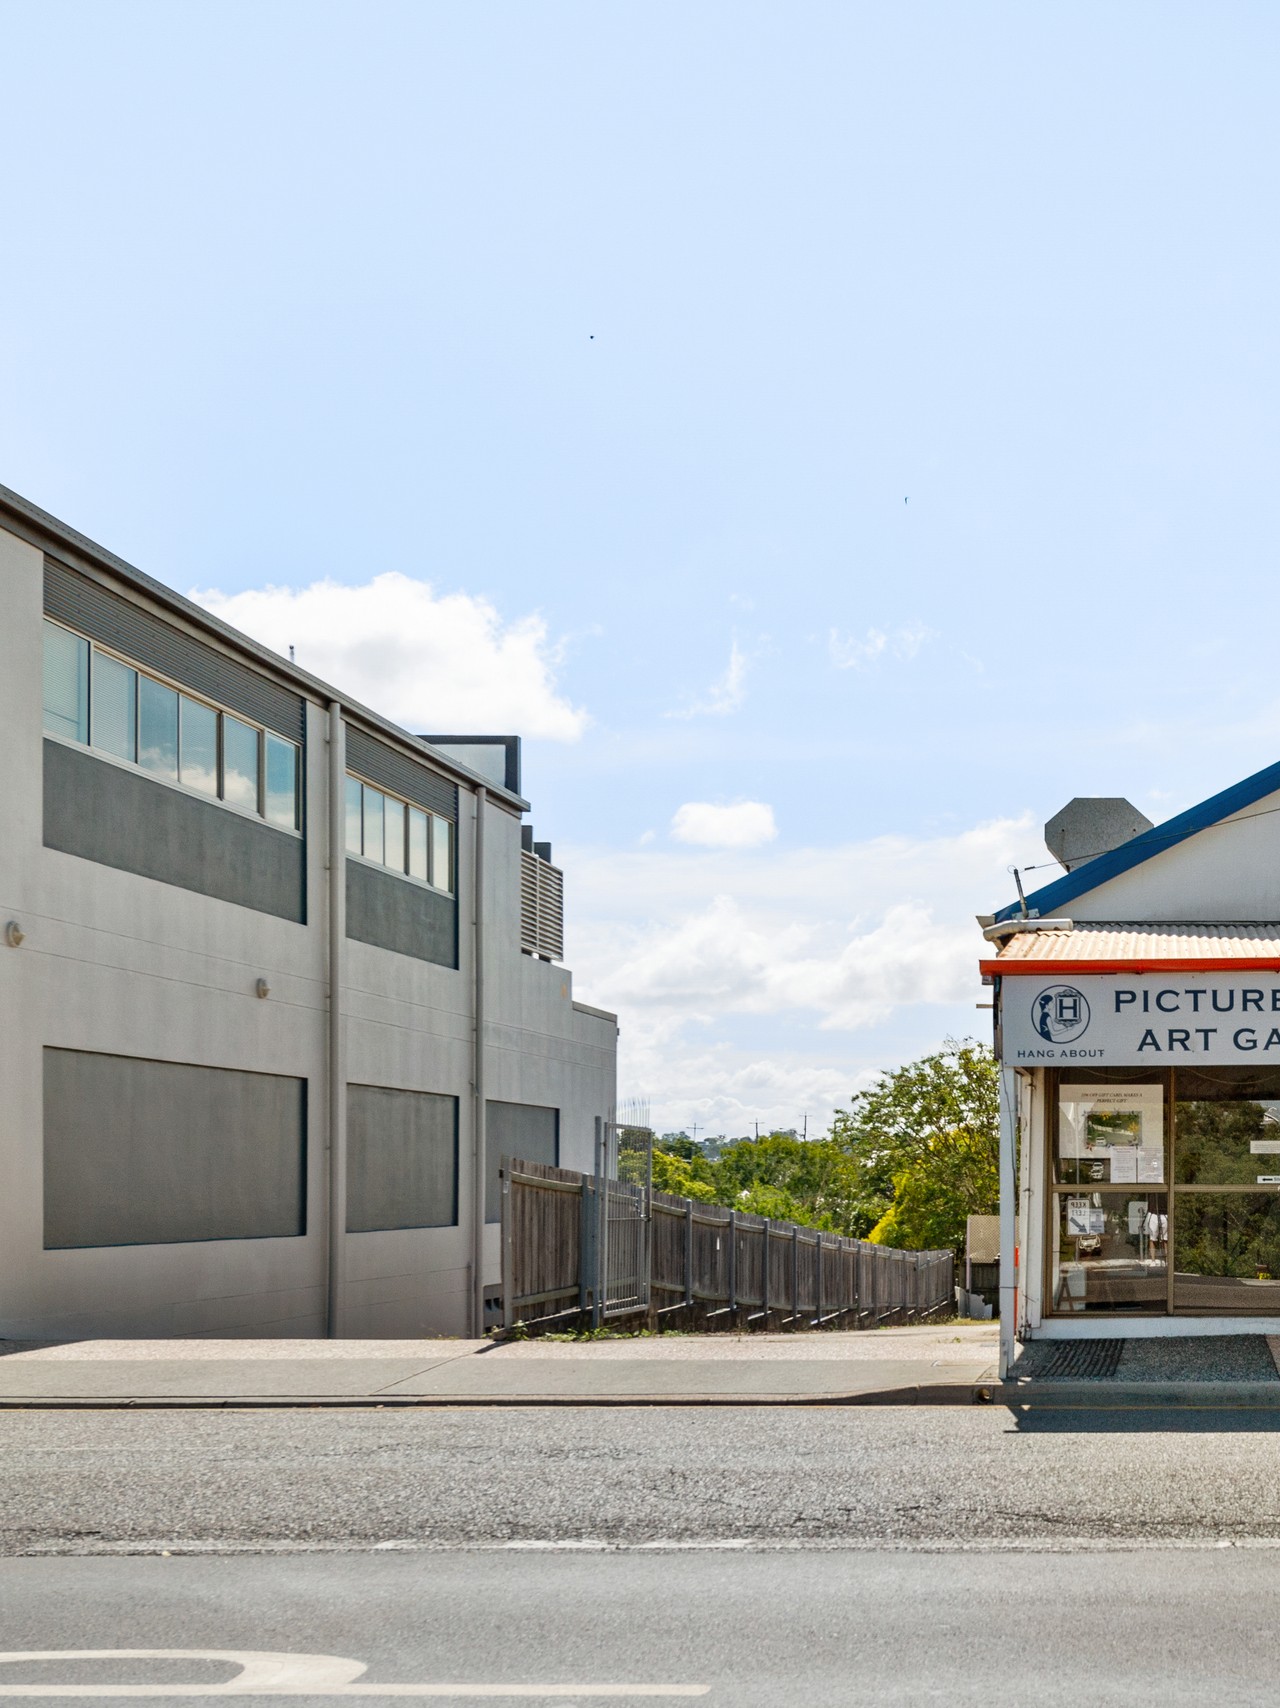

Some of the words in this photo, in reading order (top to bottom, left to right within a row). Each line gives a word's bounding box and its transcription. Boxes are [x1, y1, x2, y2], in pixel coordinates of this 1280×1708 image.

[1136, 1027, 1218, 1052] ART
[1017, 1049, 1055, 1058] HANG
[1060, 1049, 1105, 1058] ABOUT
